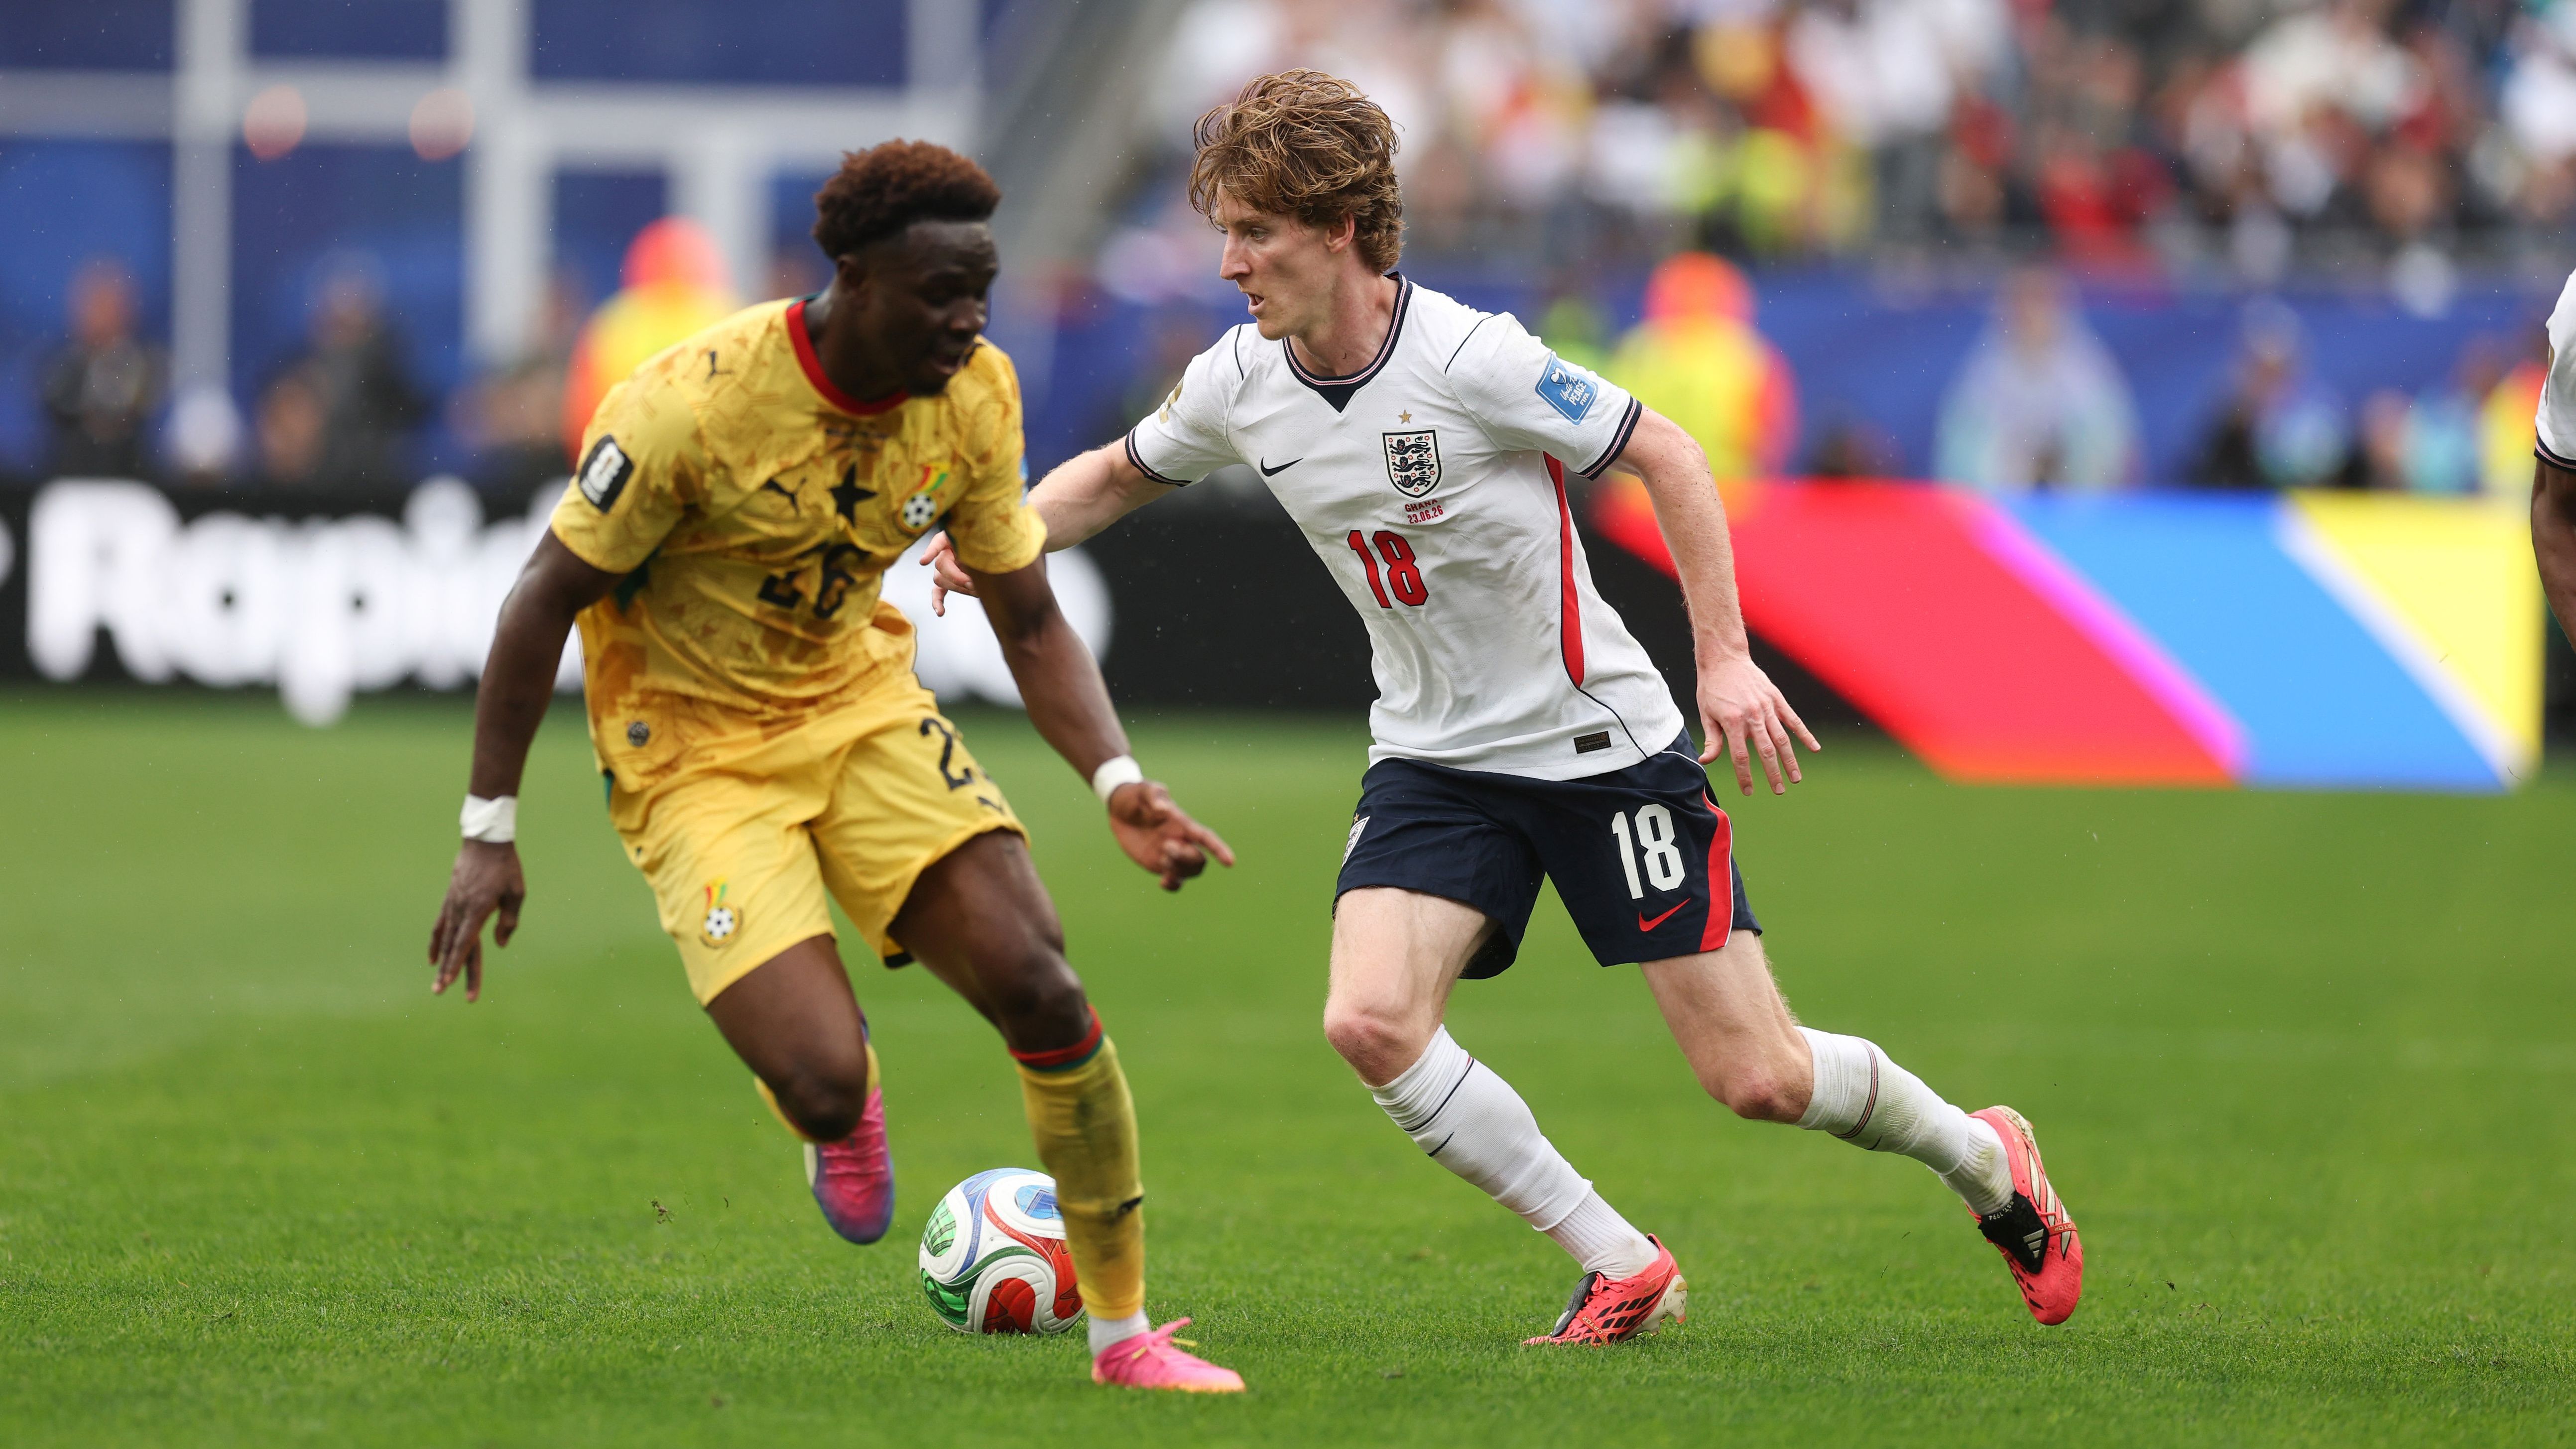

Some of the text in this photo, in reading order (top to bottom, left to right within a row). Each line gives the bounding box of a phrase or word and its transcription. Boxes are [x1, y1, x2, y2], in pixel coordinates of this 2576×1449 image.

[1560, 382, 1573, 400] Unite
[1569, 380, 1587, 406] PEACE
[1580, 392, 1590, 406] FIFA
[1405, 498, 1438, 512] GHANA
[1407, 505, 1444, 524] 23.06.26
[1347, 529, 1429, 608] 18
[1611, 803, 1687, 900] 18
